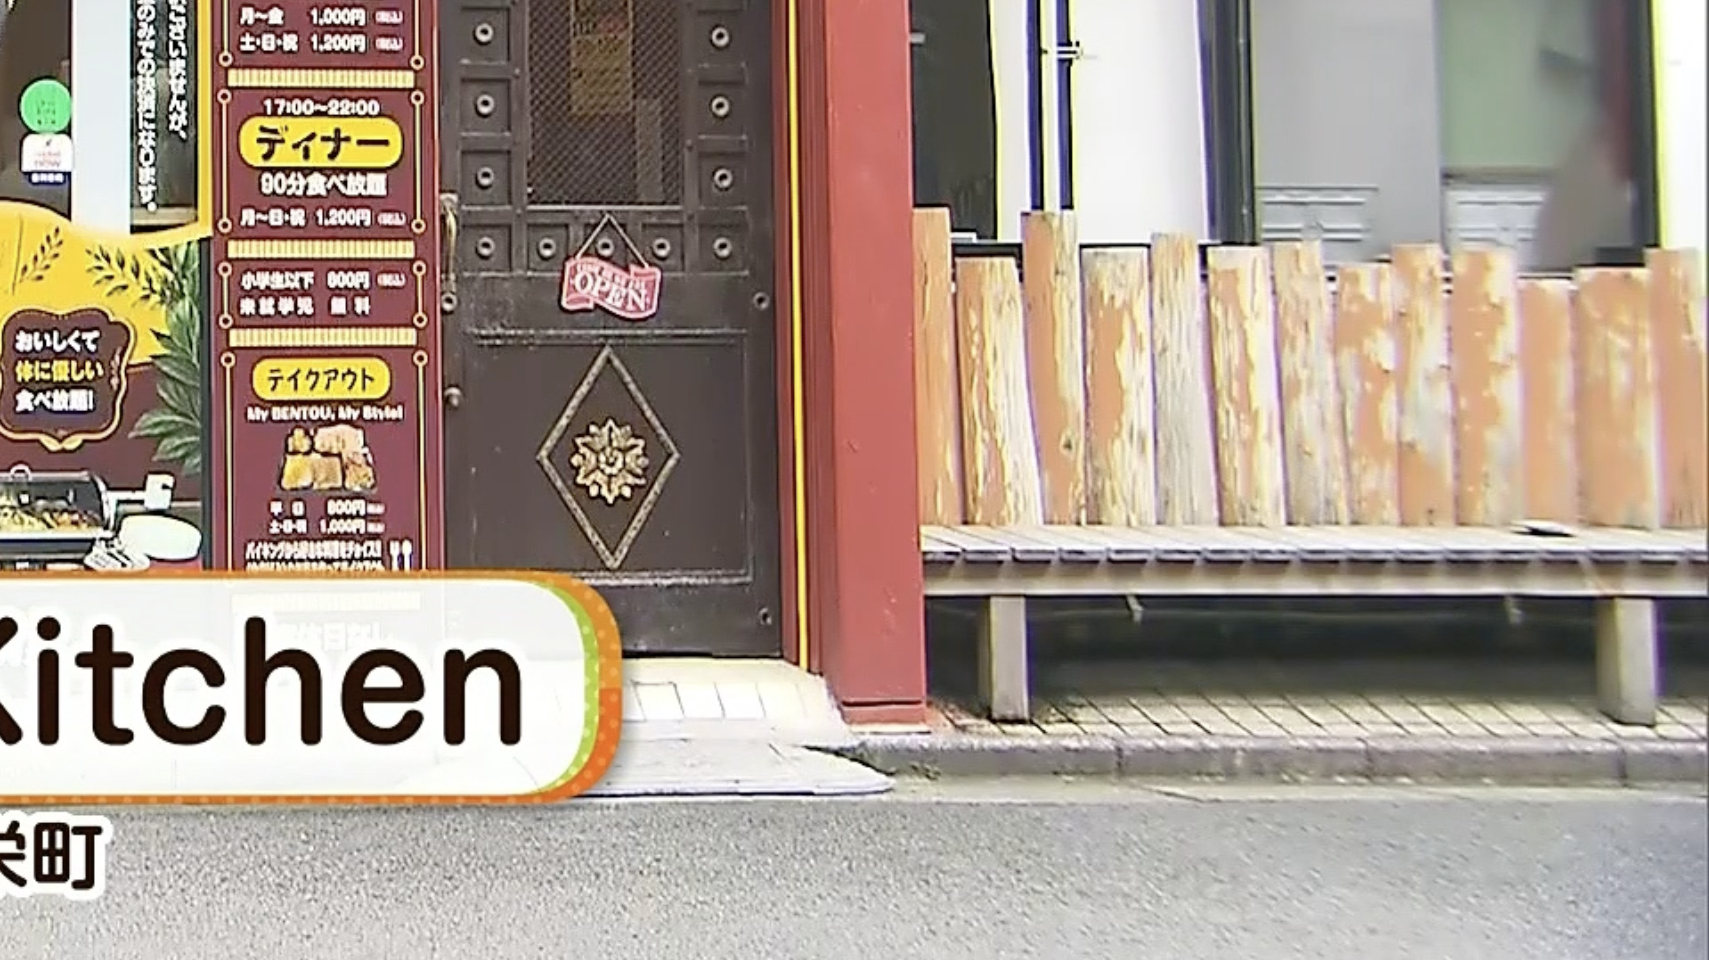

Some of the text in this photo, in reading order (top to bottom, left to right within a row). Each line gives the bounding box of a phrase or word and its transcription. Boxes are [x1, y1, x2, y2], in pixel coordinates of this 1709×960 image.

[256, 124, 391, 162] ディナー
[574, 271, 648, 312] OPEN
[14, 329, 101, 353] おいしくて
[14, 359, 105, 383] 体に優しい
[268, 367, 376, 393] テイクアウト
